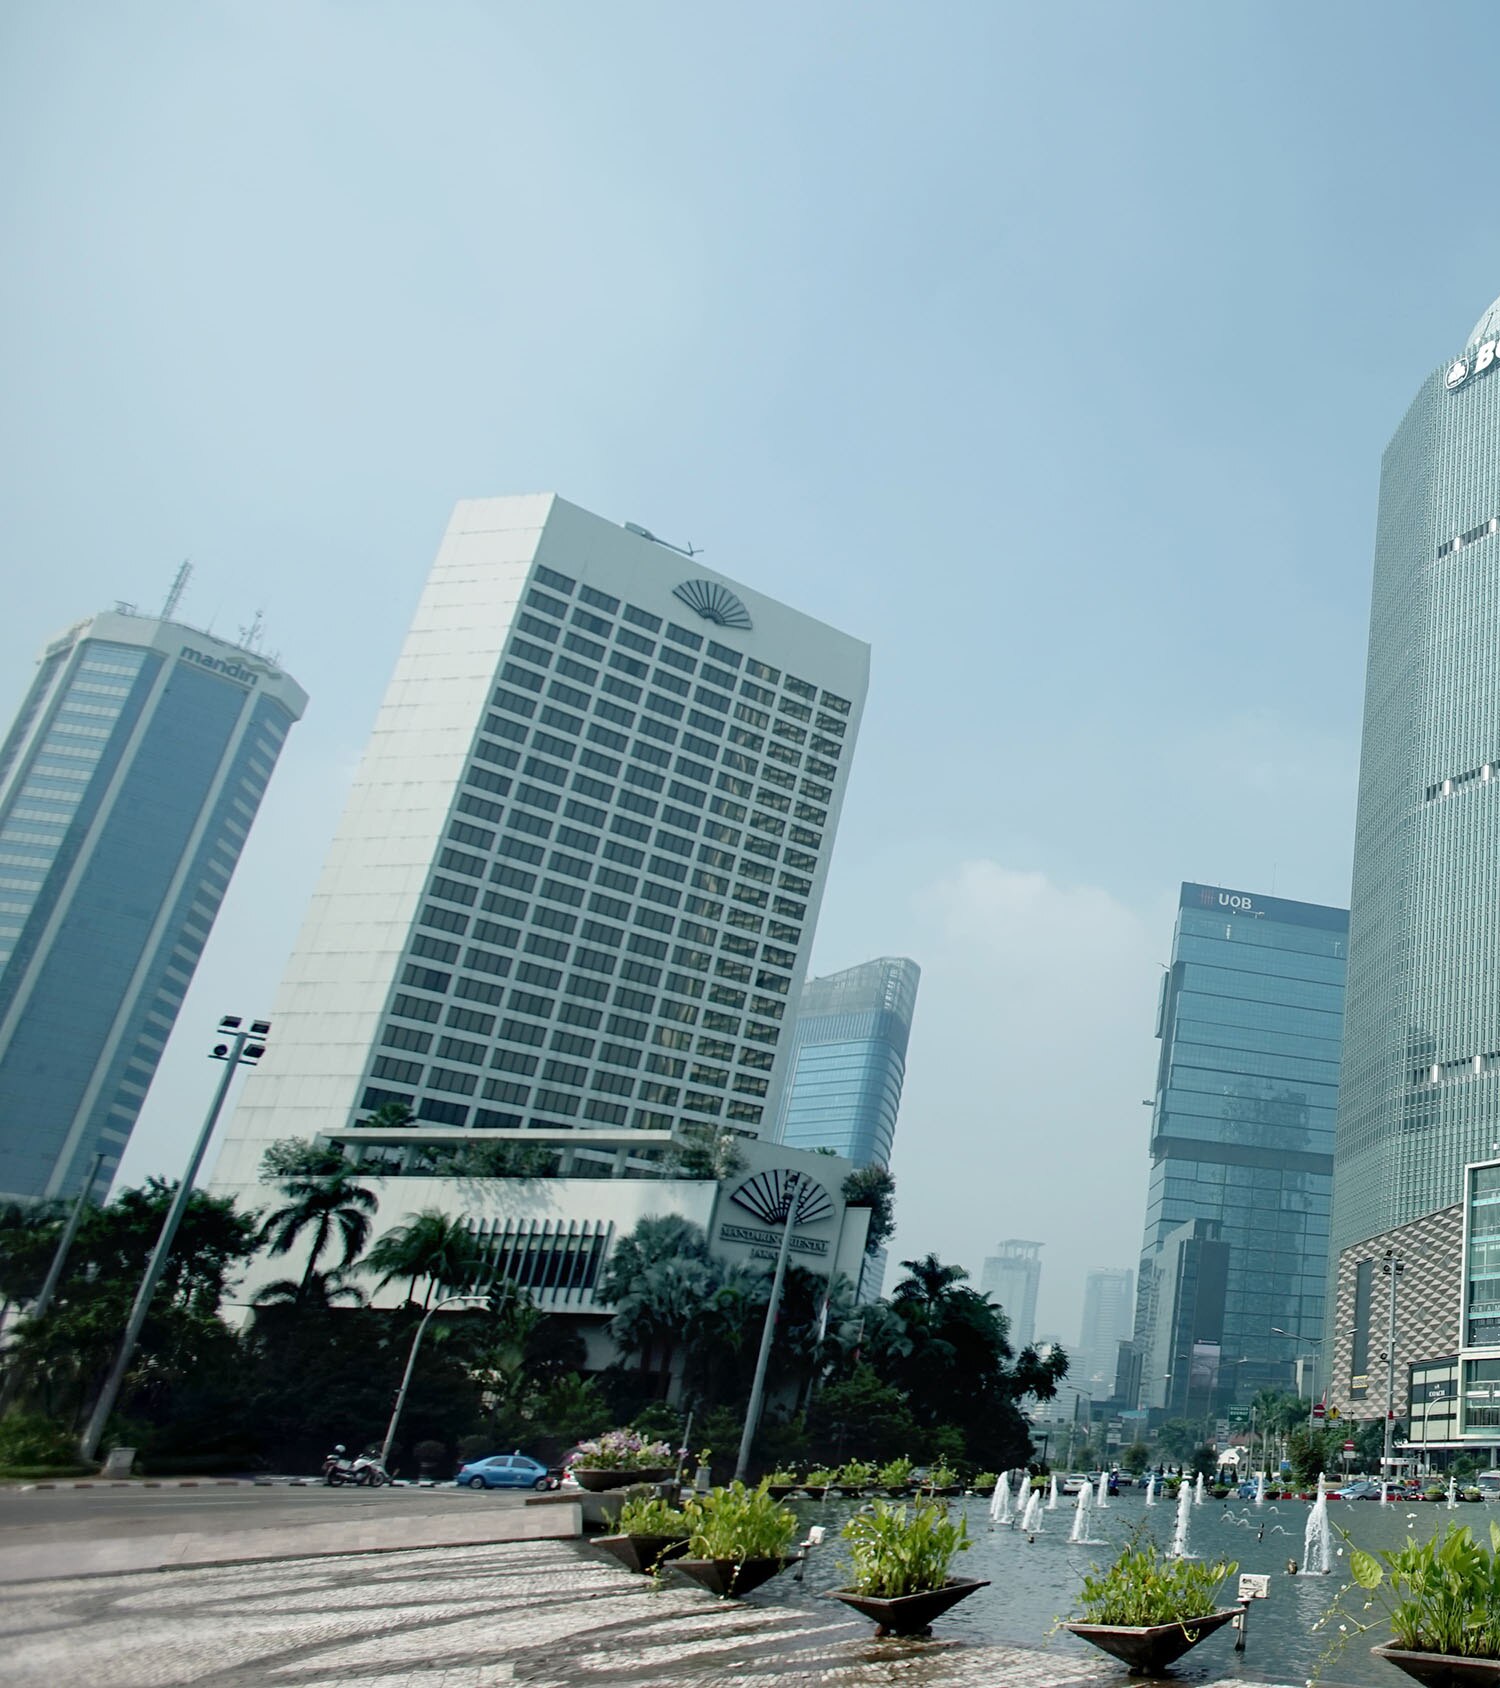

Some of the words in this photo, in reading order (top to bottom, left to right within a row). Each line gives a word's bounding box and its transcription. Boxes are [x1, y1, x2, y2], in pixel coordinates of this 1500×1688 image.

[1219, 893, 1251, 909] UOB
[721, 1227, 778, 1244] MANDARIN
[779, 1236, 828, 1252] RIENTAL
